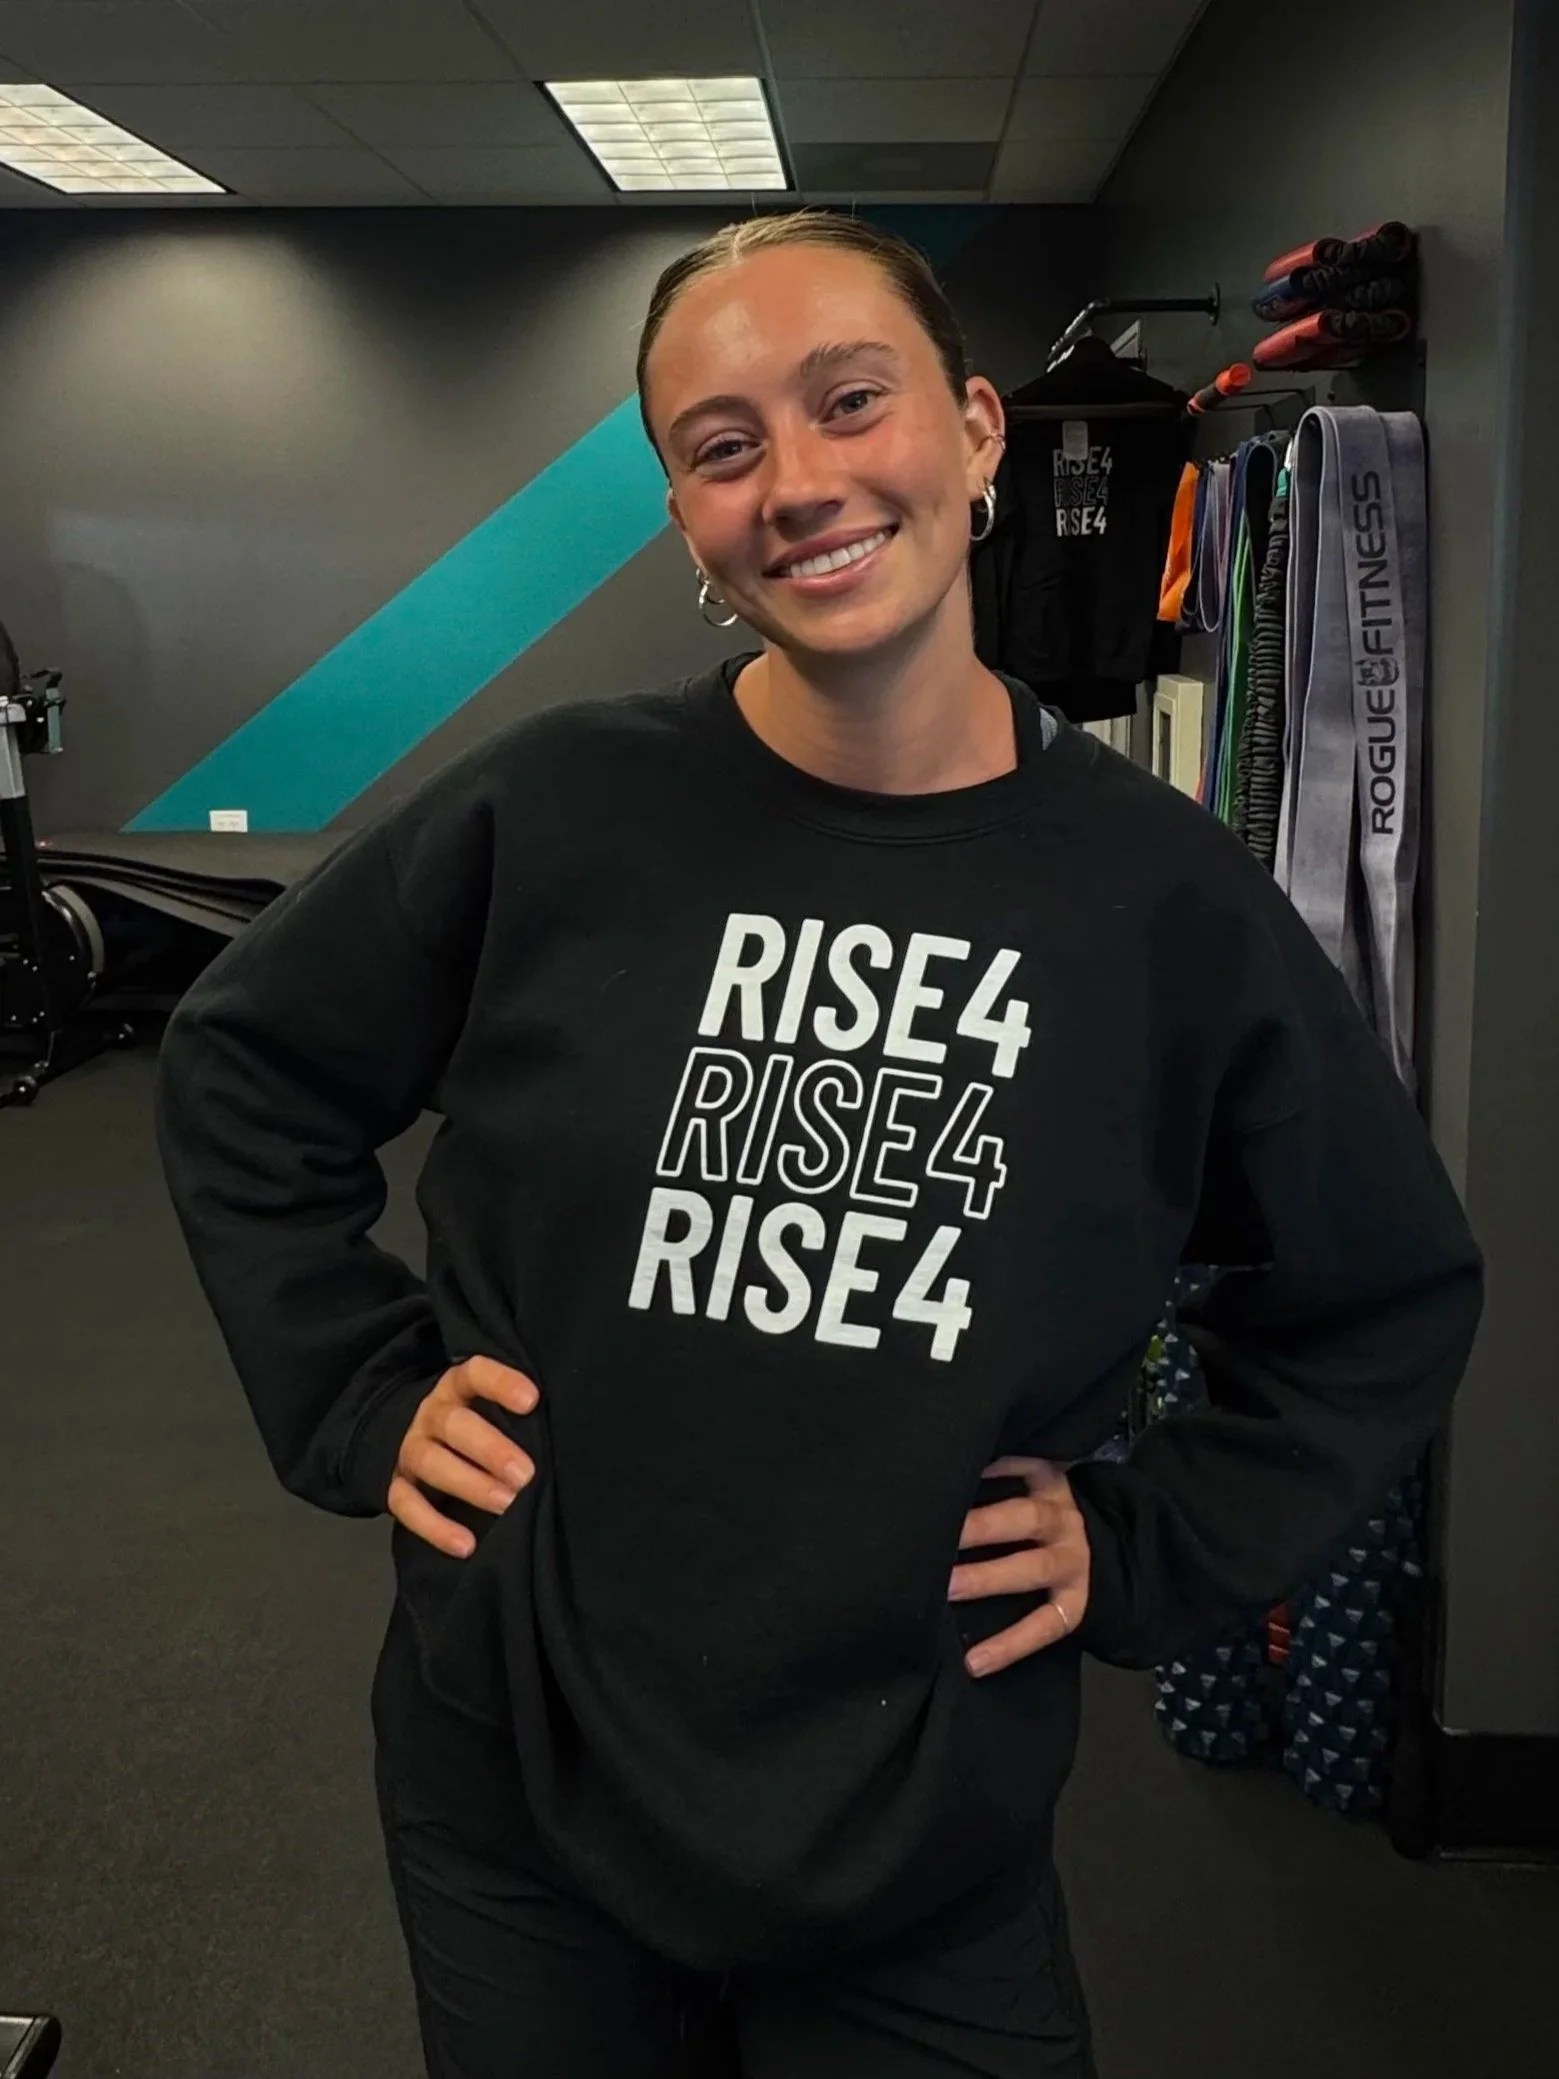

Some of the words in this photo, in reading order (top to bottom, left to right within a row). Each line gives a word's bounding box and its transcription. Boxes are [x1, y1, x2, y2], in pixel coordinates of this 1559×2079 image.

[1352, 470, 1394, 656] FITNESS
[1367, 689, 1396, 835] ROGUE
[698, 913, 1032, 1078] RISE4
[656, 1047, 1007, 1220] RISE4
[628, 1187, 972, 1362] RISE4
